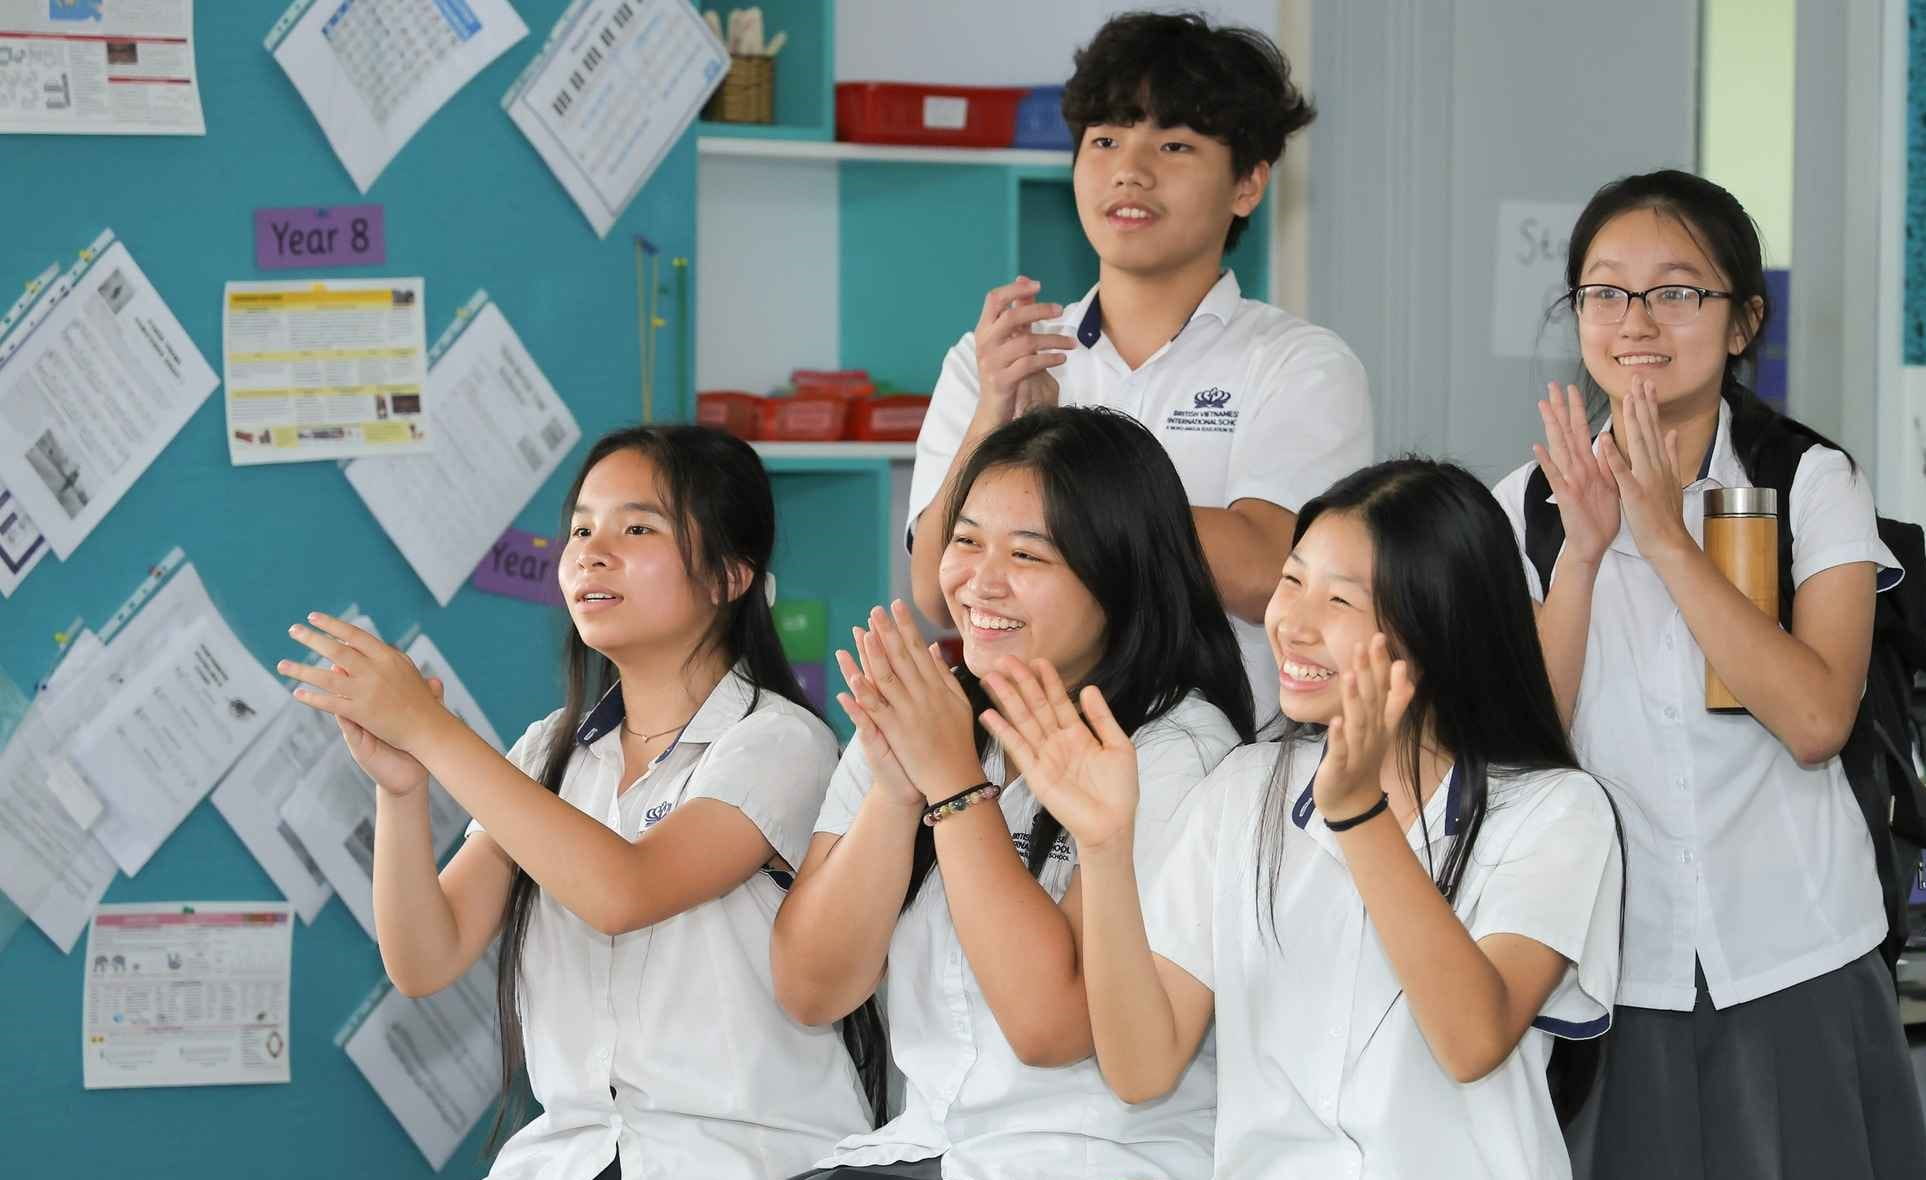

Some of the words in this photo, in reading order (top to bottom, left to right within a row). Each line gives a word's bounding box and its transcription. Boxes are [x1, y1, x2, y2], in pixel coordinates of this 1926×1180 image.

[271, 220, 338, 256] Year
[351, 217, 369, 254] 8
[1199, 410, 1239, 418] VIETNAMES
[1167, 417, 1216, 425] INTERNATIONAL
[491, 541, 549, 582] Year
[1048, 852, 1070, 861] SCHOOL
